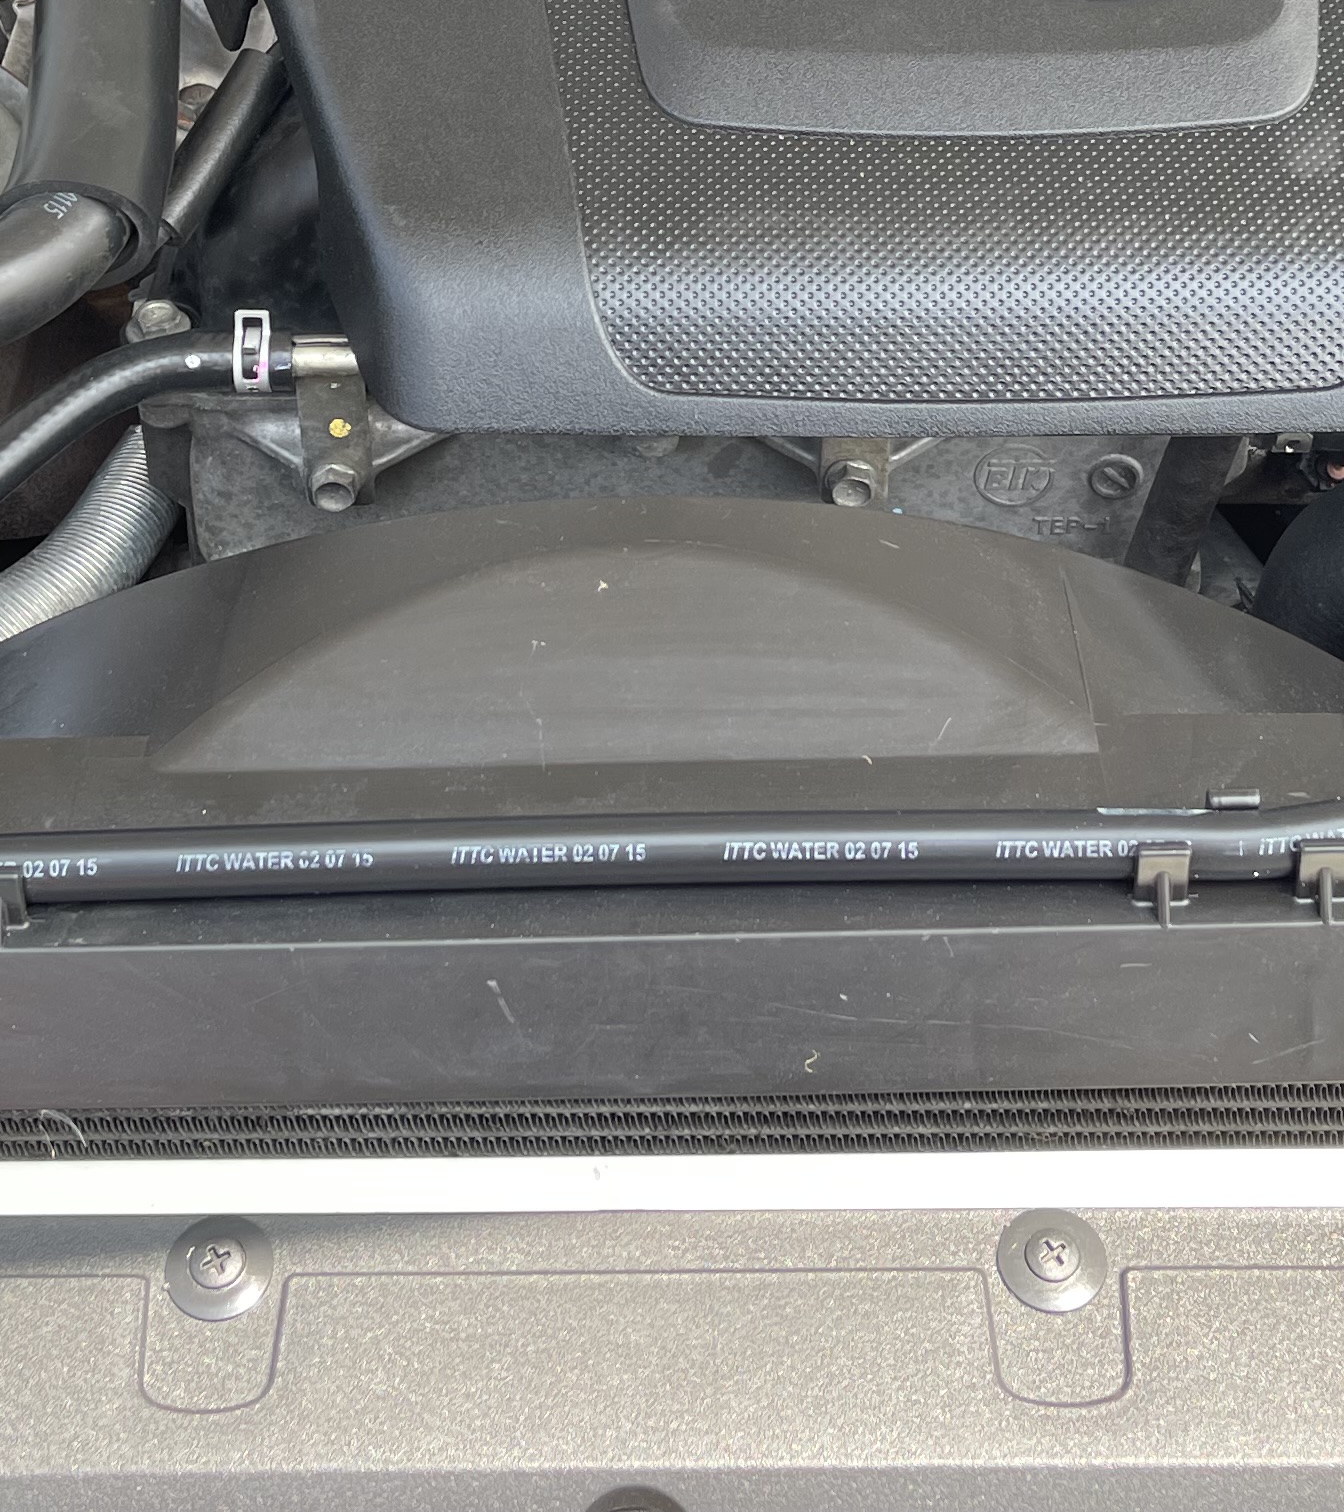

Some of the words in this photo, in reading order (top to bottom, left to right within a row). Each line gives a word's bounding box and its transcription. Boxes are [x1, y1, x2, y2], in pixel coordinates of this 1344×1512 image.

[43, 193, 78, 219] 0115
[498, 844, 568, 864] WATER
[573, 844, 594, 863] 02
[598, 843, 621, 862] 07
[625, 843, 646, 862] 15
[771, 841, 840, 861] WATER
[844, 841, 867, 860] 02
[870, 841, 893, 860] 07
[897, 840, 919, 859] 15
[1043, 839, 1113, 858] WATER
[1117, 839, 1139, 858] 02
[23, 860, 44, 878] 02
[48, 859, 71, 877] 07
[76, 858, 98, 876] 15
[224, 851, 294, 872] WATER
[325, 850, 347, 868] 07
